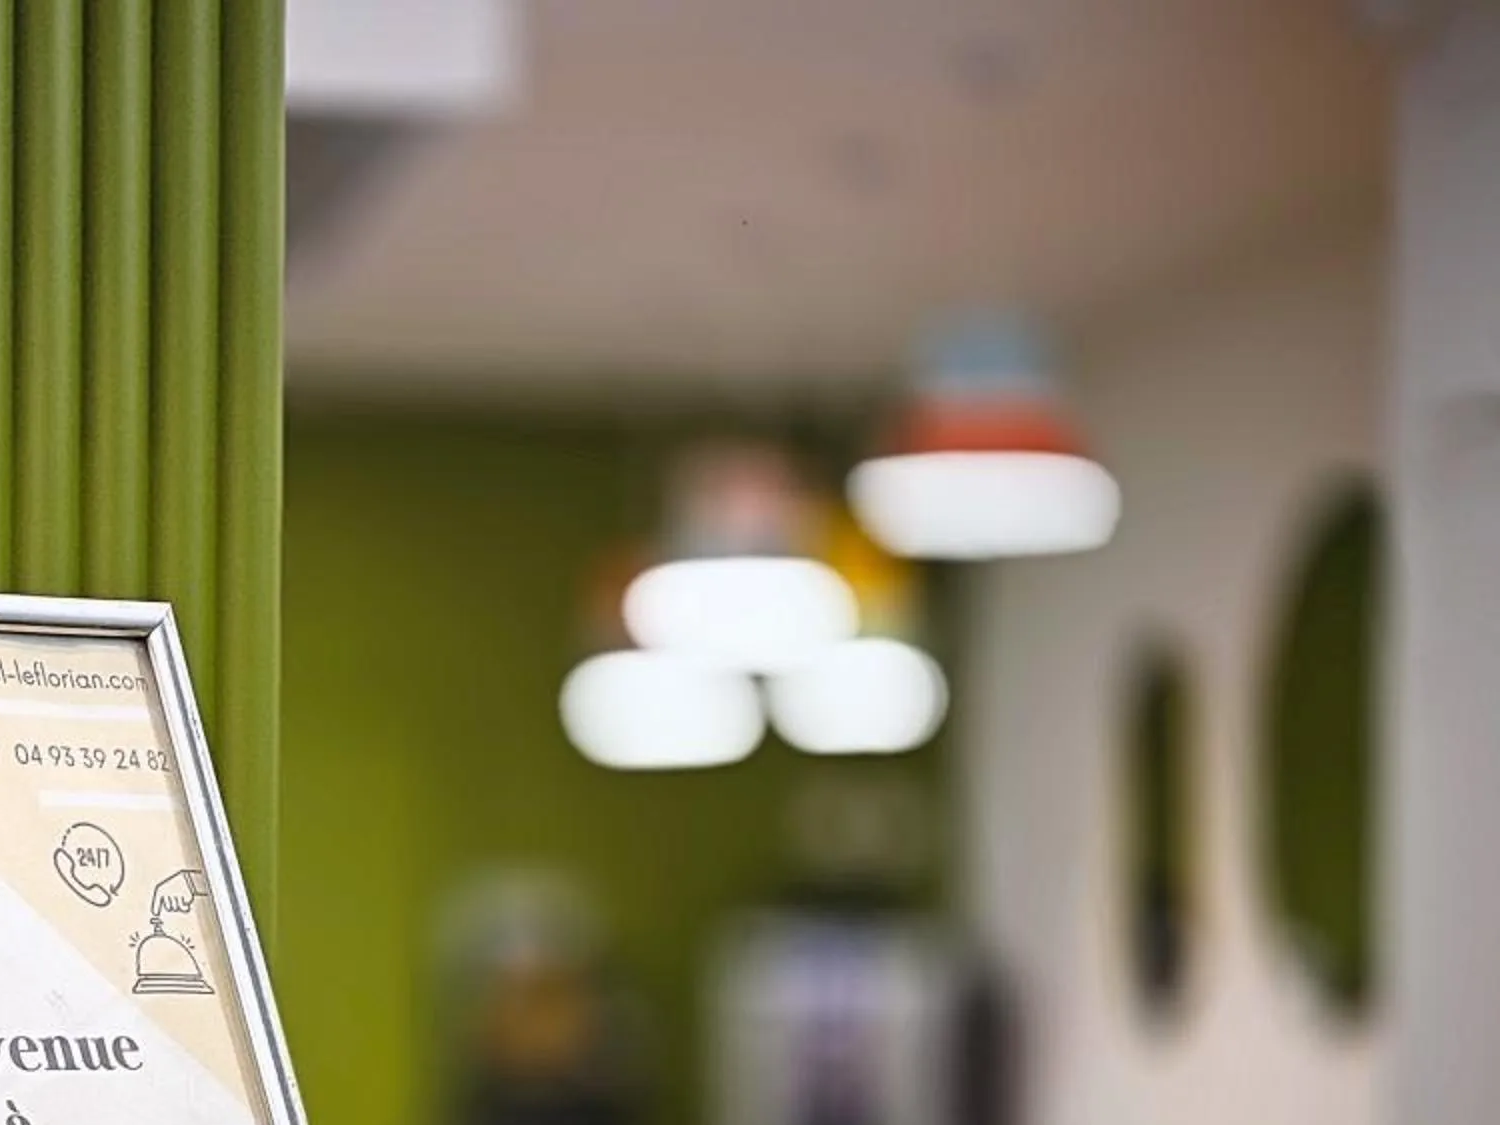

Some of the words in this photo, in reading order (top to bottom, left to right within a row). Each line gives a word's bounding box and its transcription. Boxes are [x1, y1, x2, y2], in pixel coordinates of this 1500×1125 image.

[14, 743, 43, 766] 04
[48, 745, 75, 767] 93
[79, 747, 106, 769] 39
[113, 749, 141, 770] 24
[146, 749, 173, 773] 82
